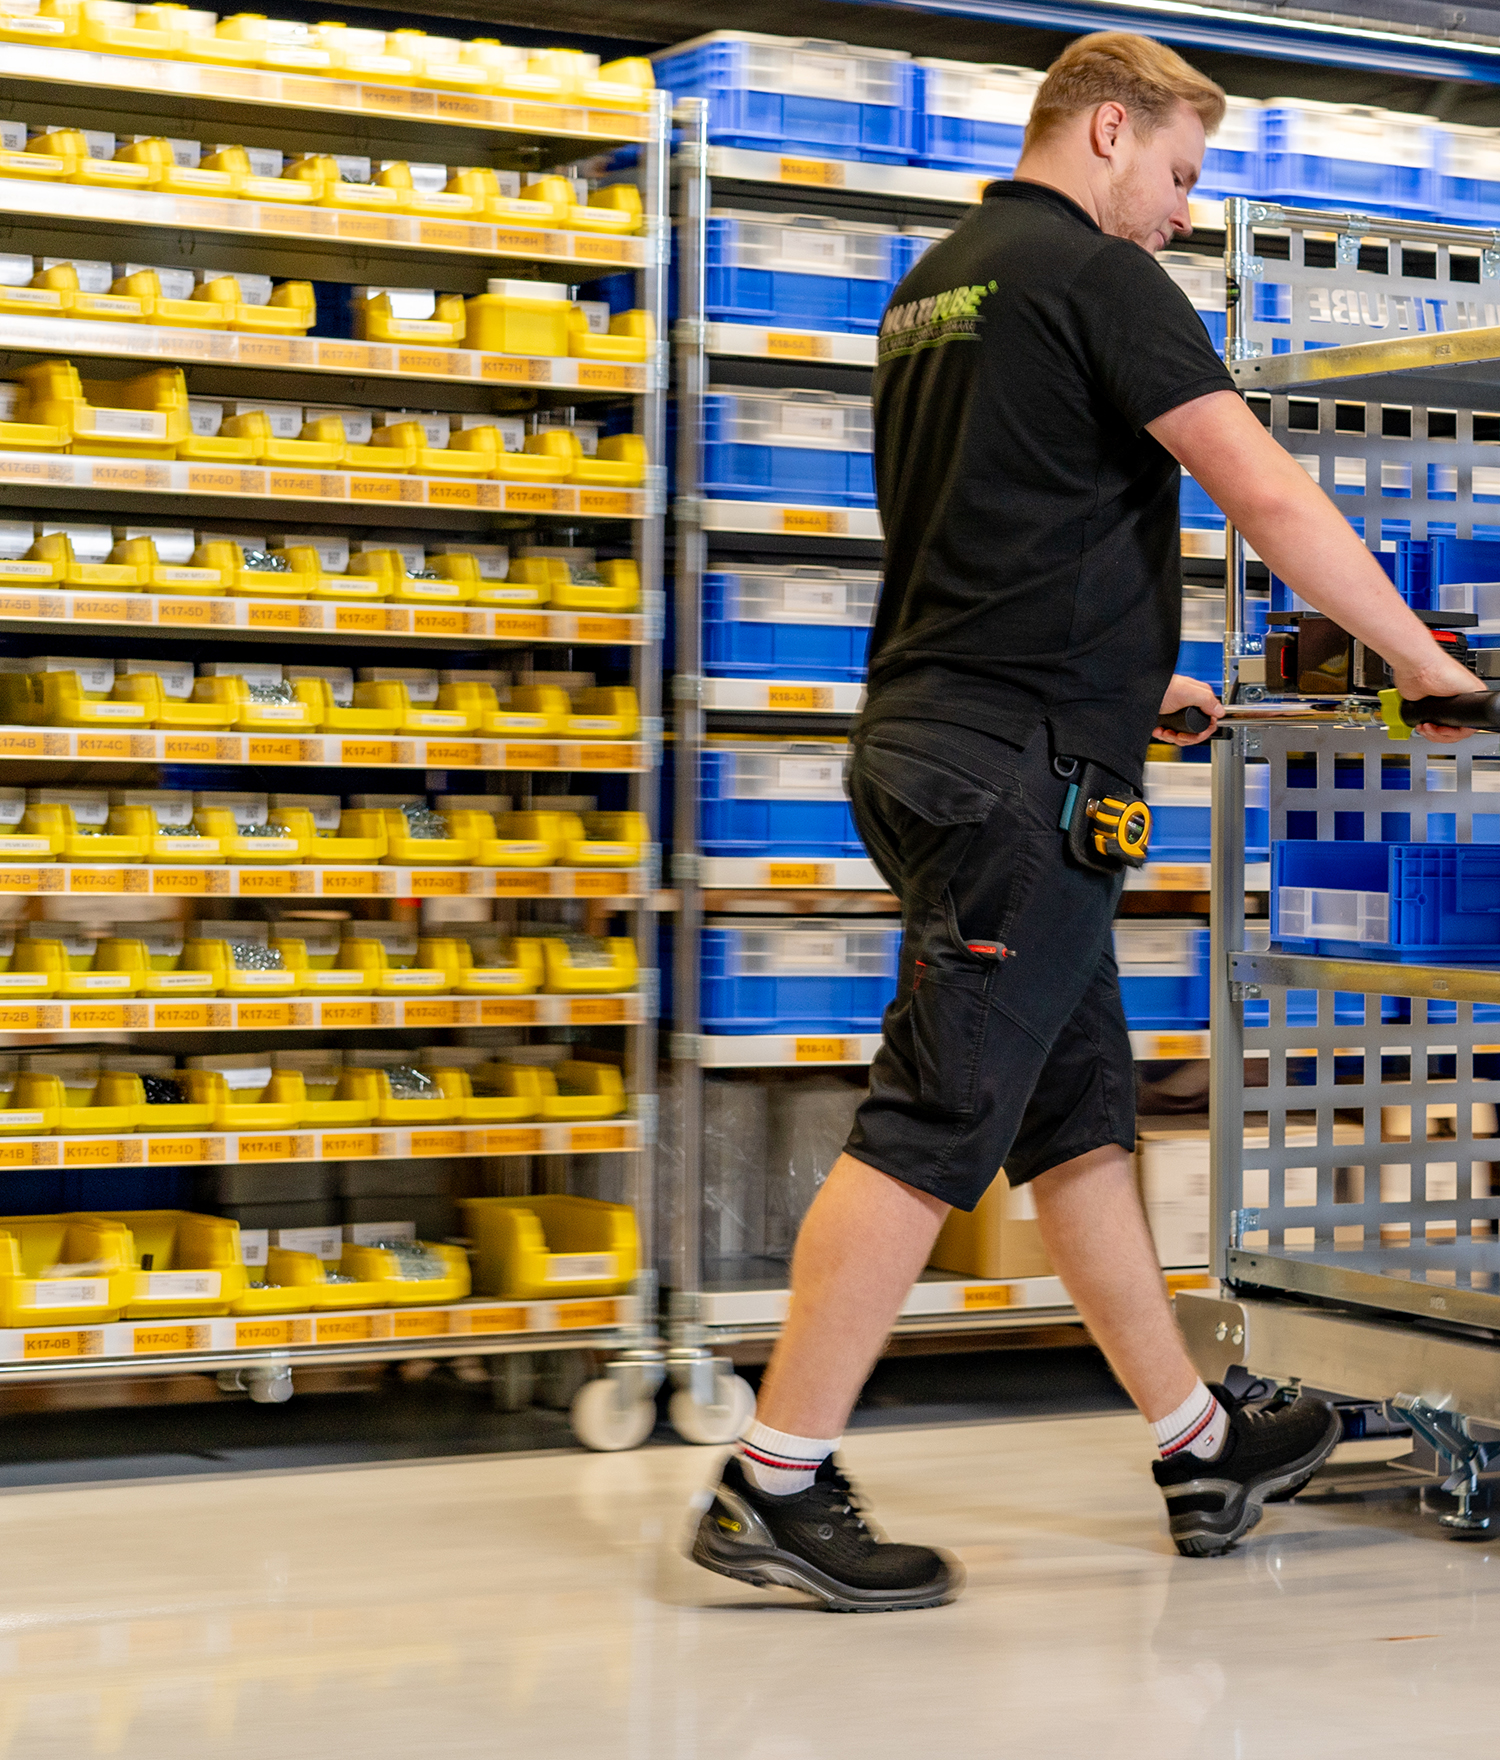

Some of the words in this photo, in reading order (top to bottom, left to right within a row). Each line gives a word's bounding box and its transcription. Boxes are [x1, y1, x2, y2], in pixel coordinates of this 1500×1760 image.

[241, 343, 281, 355] K17-7E
[400, 355, 442, 368] K17-7G
[483, 361, 523, 374] K17-7H
[95, 467, 138, 479] K17-6C
[192, 473, 234, 486] K17-6D
[273, 477, 314, 489] K17-6E
[352, 482, 392, 494] K17-6F
[430, 486, 471, 499] K17-6G
[507, 490, 546, 503] K17-6H
[76, 602, 119, 614] K17-5C
[161, 605, 203, 617] K17-5D
[251, 609, 292, 621] K17-5E
[338, 613, 378, 625] K17-5F
[771, 692, 807, 702] K18-3A
[80, 739, 123, 751] K17-4C
[167, 741, 210, 753] K17-4D
[251, 743, 292, 755] K17-4E
[344, 746, 384, 757] K17-4F
[73, 874, 116, 886] K17-3C
[156, 875, 198, 887] K17-3D
[242, 876, 283, 887] K17-3E
[325, 876, 365, 887] K17-3F
[73, 1010, 116, 1021] K17-2C
[157, 1010, 199, 1021] K17-2D
[240, 1009, 281, 1020] K17-2E
[324, 1007, 363, 1019] K17-2F
[797, 1044, 834, 1053] K18-1A
[66, 1146, 110, 1158] K17-1C
[150, 1144, 193, 1155] K17-1D
[241, 1142, 282, 1154] K17-1E
[136, 1333, 179, 1345] K17-0C
[238, 1327, 280, 1339] K17-0D
[26, 1338, 71, 1351] K17-0B
